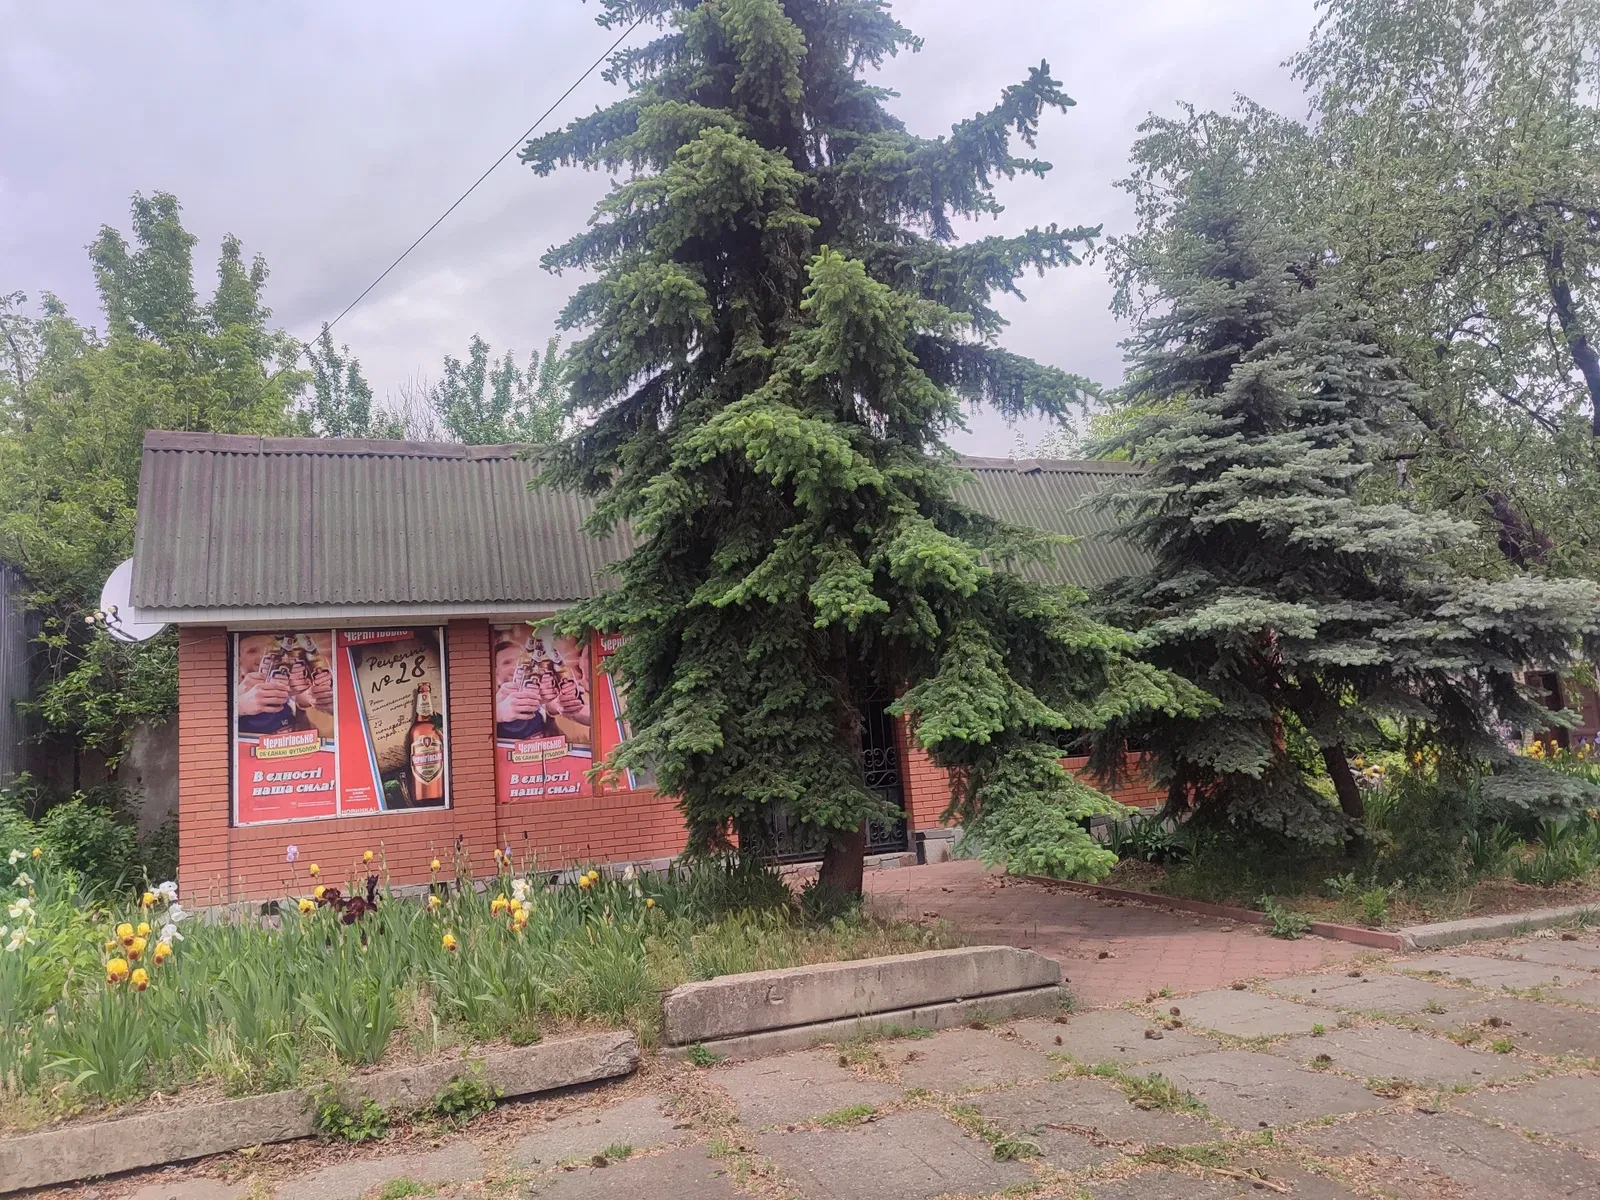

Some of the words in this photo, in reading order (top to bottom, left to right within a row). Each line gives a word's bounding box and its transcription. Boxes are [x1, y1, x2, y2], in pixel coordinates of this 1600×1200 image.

[263, 733, 314, 749] Чернігівське
[518, 739, 562, 753] Чернігівське
[289, 745, 317, 755] ФУТБОЛОМ
[541, 750, 565, 758] УТБОЛОМ
[252, 771, 264, 783] В
[266, 766, 323, 782] єдності
[510, 774, 520, 785] В
[521, 770, 570, 784] єдності
[252, 784, 294, 796] наша
[296, 779, 335, 793] сила!
[510, 787, 544, 797] наша
[547, 782, 581, 795] сила!
